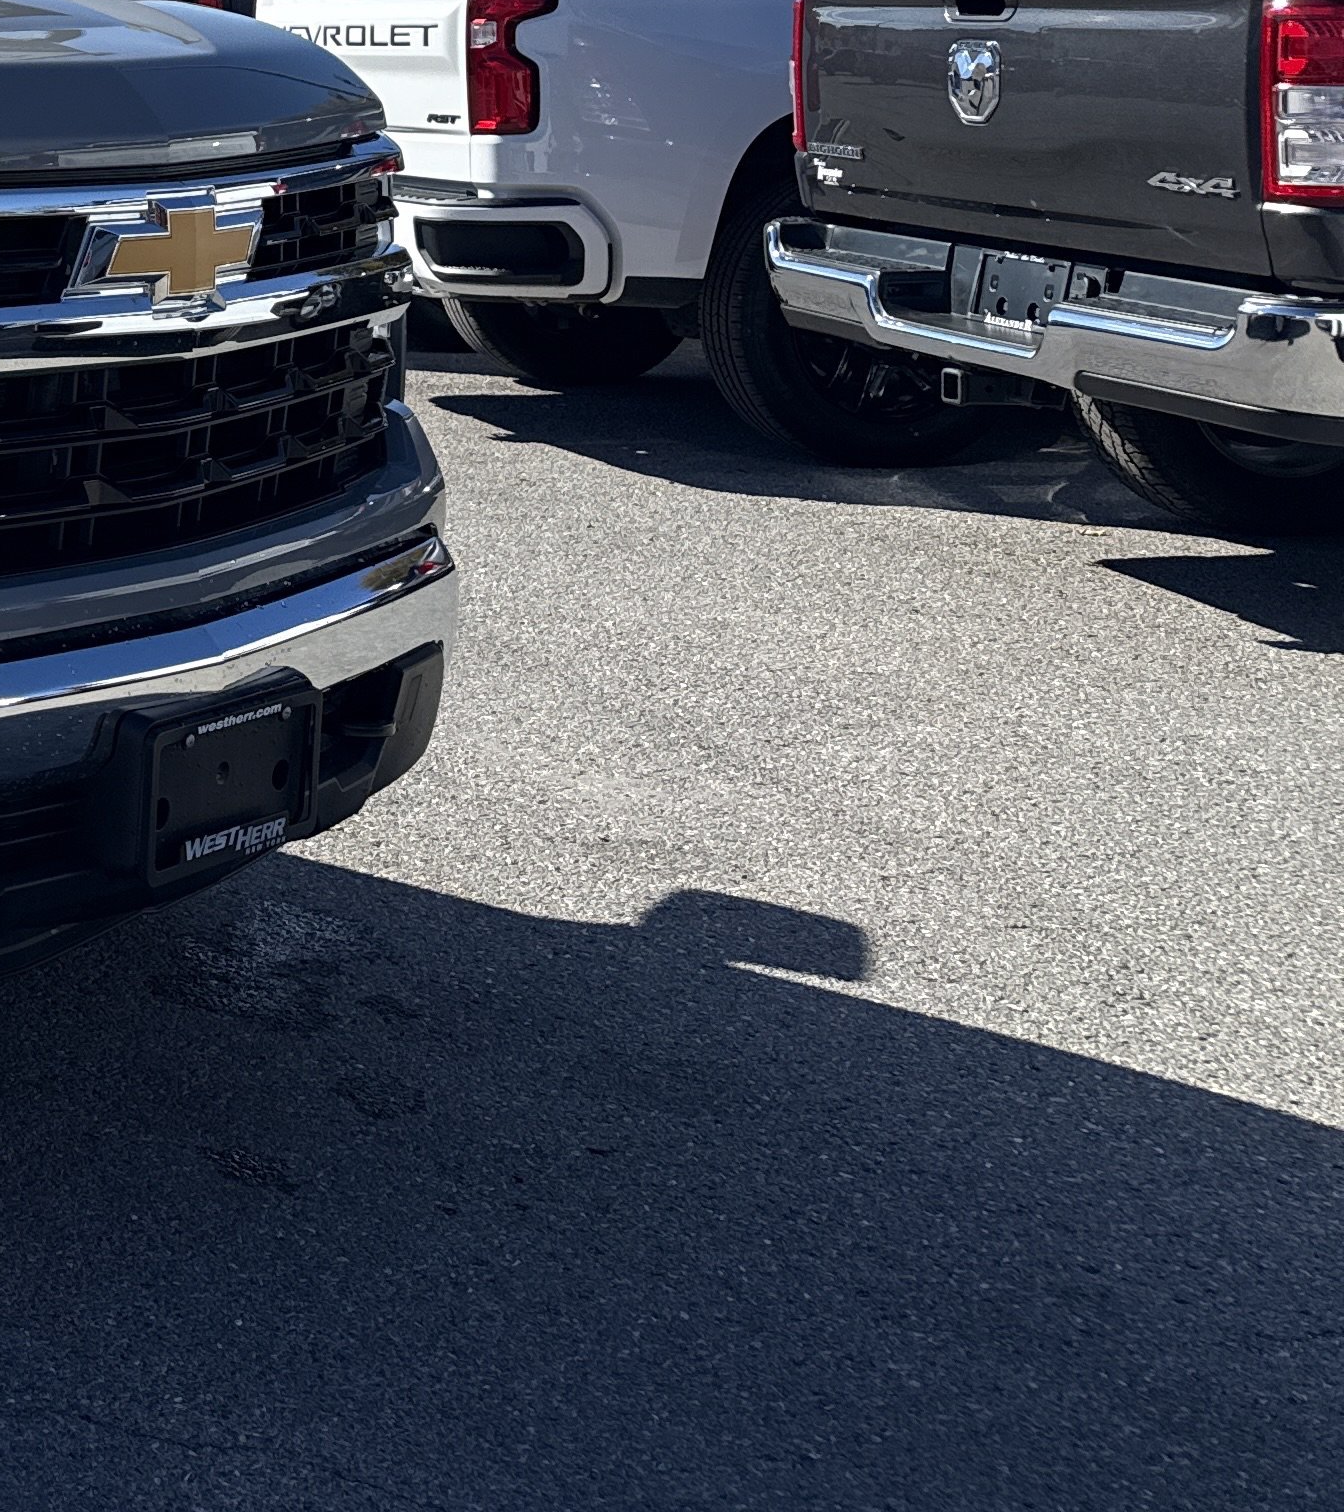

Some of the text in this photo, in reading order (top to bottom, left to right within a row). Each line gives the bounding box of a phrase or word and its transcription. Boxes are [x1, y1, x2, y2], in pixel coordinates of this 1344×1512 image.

[283, 23, 439, 47] VROLET
[426, 113, 462, 124] RST
[197, 703, 283, 735] westherr.com
[245, 835, 287, 855] NEW YORK
